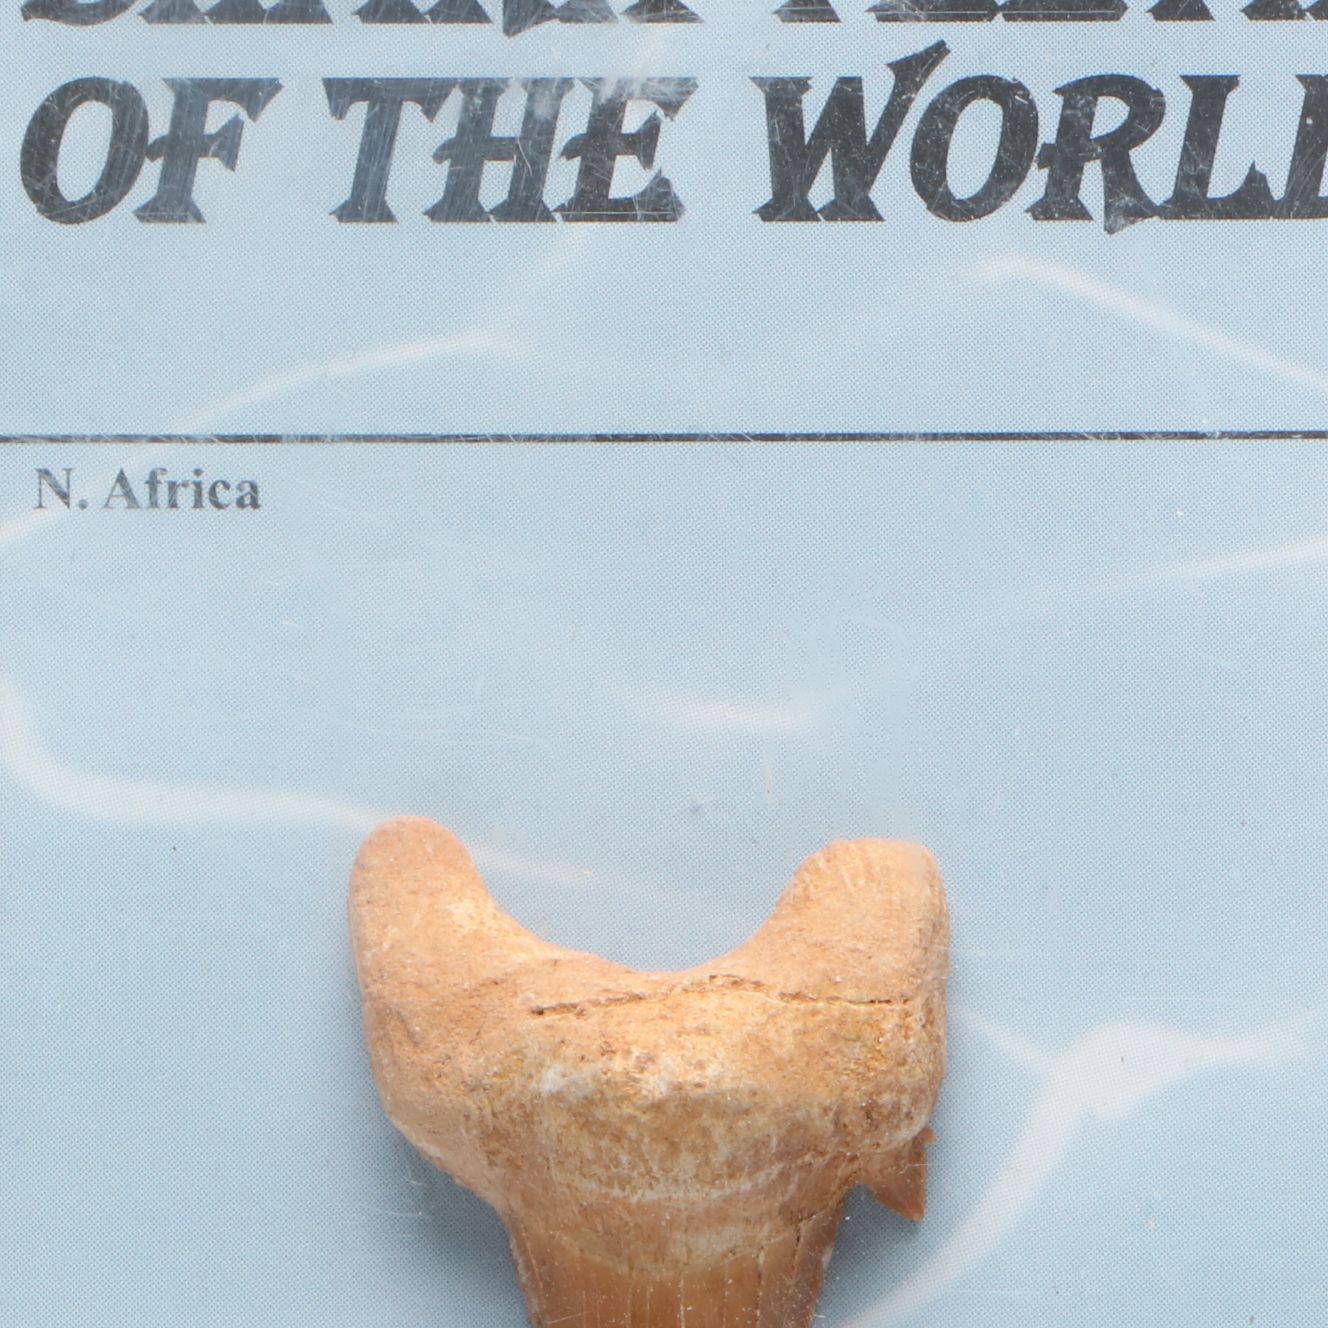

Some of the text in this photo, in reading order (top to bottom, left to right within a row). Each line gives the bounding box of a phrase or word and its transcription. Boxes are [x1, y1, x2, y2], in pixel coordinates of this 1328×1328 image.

[18, 76, 283, 225] OF
[321, 77, 700, 223] THE
[34, 467, 262, 510] N. Africa
